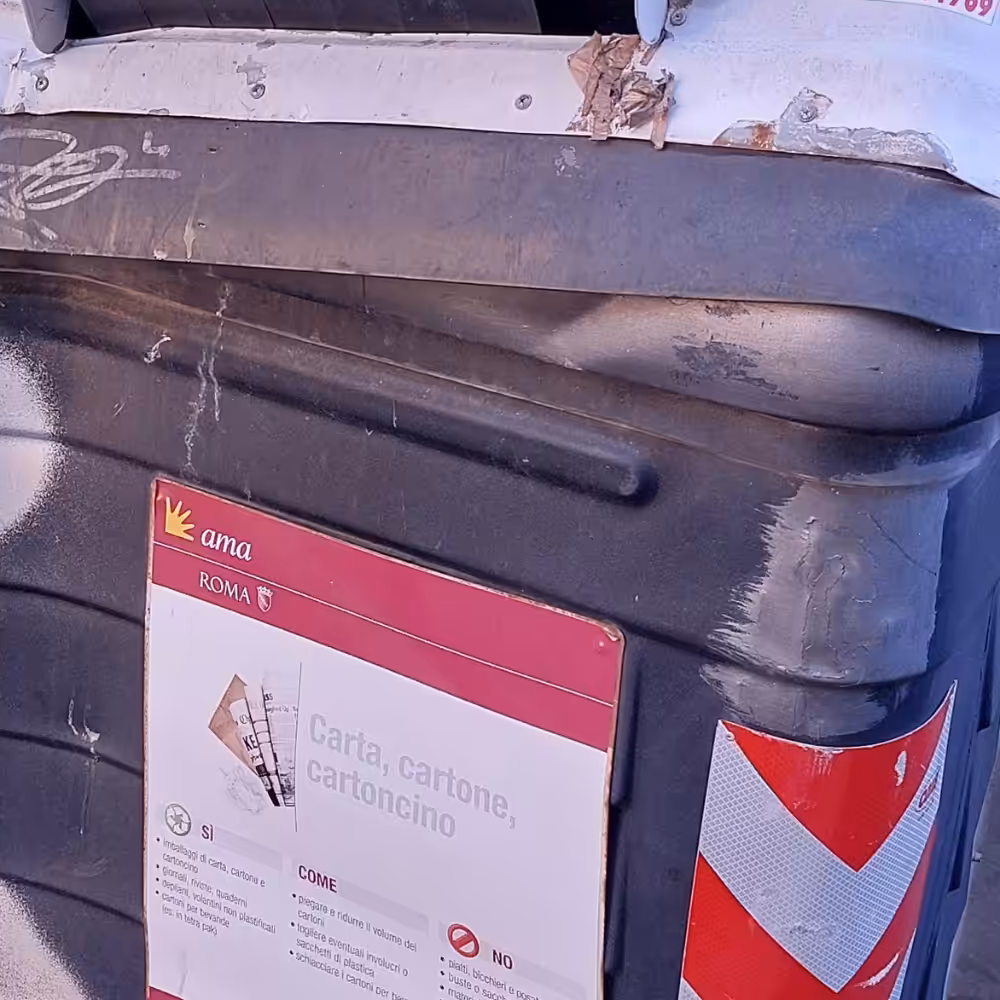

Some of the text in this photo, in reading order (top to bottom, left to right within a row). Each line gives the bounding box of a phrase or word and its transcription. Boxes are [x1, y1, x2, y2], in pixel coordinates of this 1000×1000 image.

[201, 529, 252, 561] ama
[200, 571, 251, 605] ROMA
[309, 713, 516, 829] Carta, cartone,
[307, 759, 456, 838] cartoncino
[163, 853, 198, 873] cartoncino
[200, 853, 207, 864] di
[208, 857, 229, 874] carta,
[298, 865, 337, 893] COME
[216, 888, 248, 908] quaderni
[223, 906, 237, 917] non
[176, 910, 183, 920] in
[184, 913, 201, 928] tetra
[187, 903, 198, 914] per
[200, 908, 229, 928] bevande
[298, 909, 324, 927] cartoni
[299, 895, 327, 913] piegare
[337, 911, 364, 929] ridurre
[373, 926, 402, 946] volume
[296, 938, 375, 978] sacchetti di plastica
[297, 922, 408, 977] togliere eventuali involucri o
[492, 949, 513, 969] NO
[296, 951, 340, 978] schiacciare
[346, 973, 374, 992] cartoni
[376, 986, 389, 998] per
[449, 972, 471, 990] buste
[474, 985, 480, 993] o
[473, 968, 506, 991] bicchieri
[509, 986, 514, 995] e
